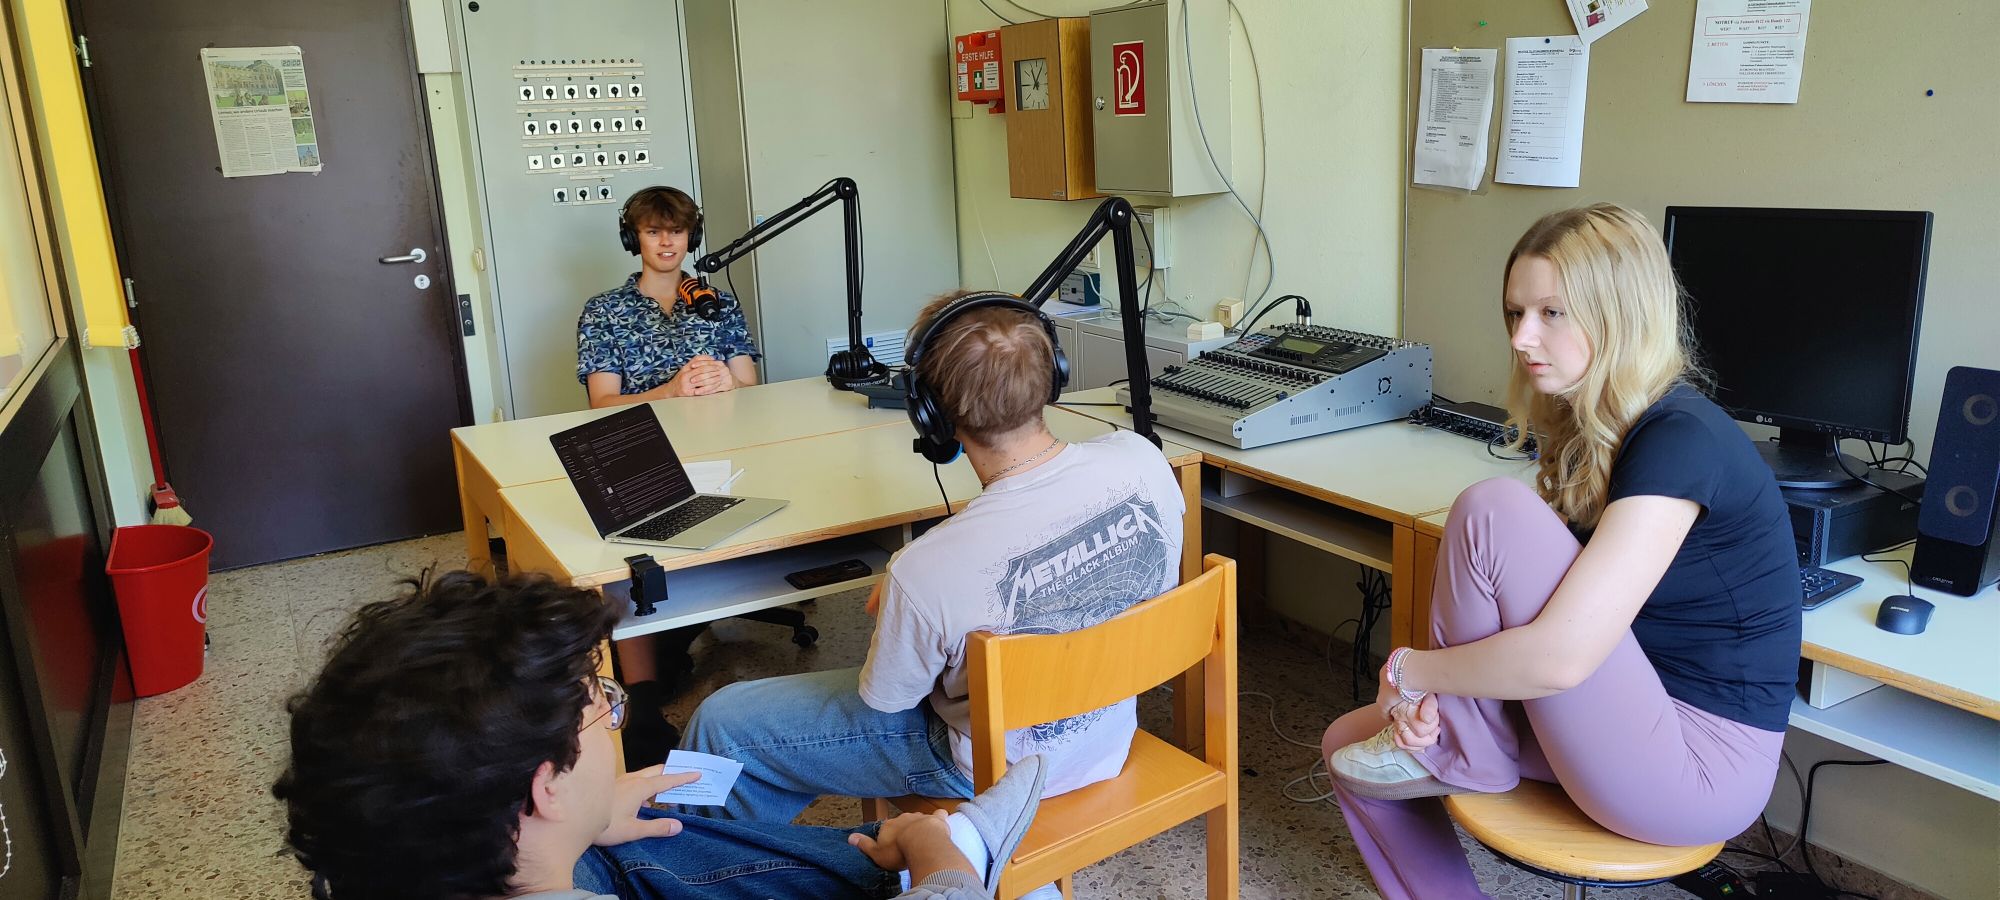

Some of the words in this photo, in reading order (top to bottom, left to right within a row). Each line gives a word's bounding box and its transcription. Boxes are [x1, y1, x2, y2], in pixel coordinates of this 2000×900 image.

[961, 51, 979, 62] ERSTE
[979, 50, 994, 60] HILFE
[1004, 501, 1177, 629] METALLICA
[1039, 583, 1063, 598] THE
[1065, 559, 1102, 586] BLACK
[1102, 536, 1139, 561] ALBUM
